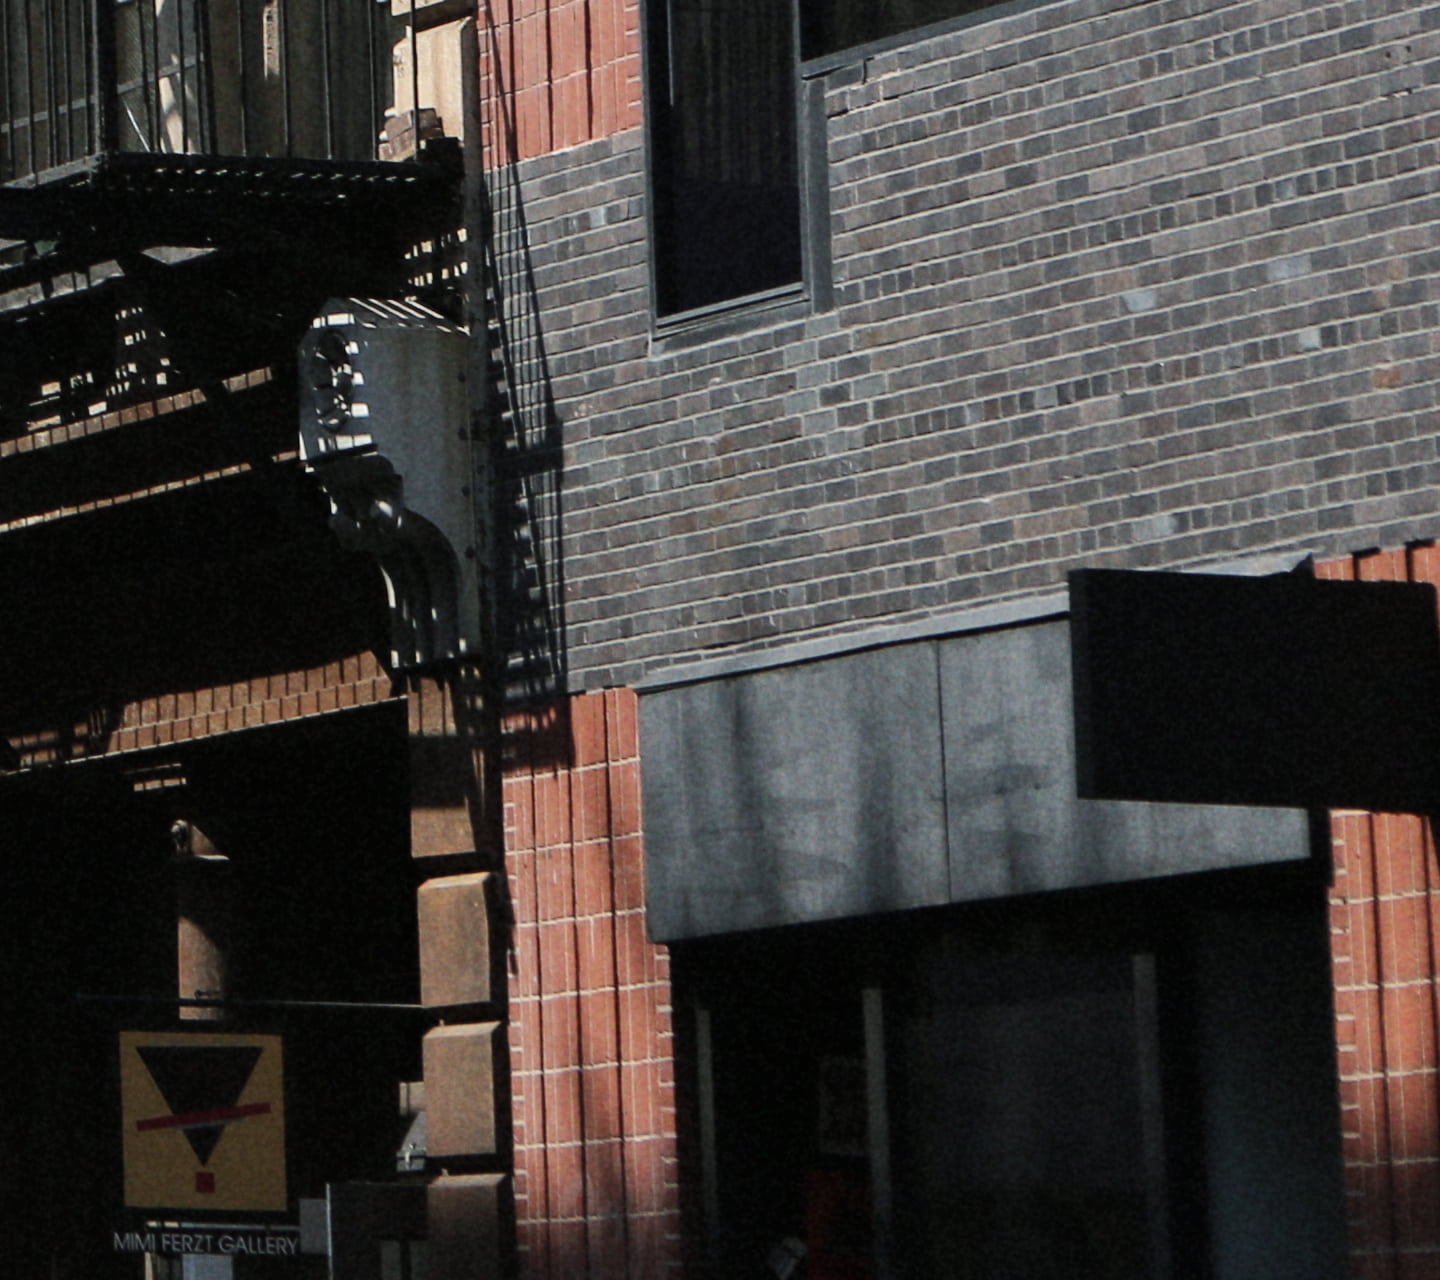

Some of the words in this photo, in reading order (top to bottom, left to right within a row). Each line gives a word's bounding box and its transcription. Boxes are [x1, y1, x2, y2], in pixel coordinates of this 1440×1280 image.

[113, 1232, 155, 1251] MIMI
[162, 1233, 213, 1253] FERZT
[218, 1235, 299, 1256] GALLERY
